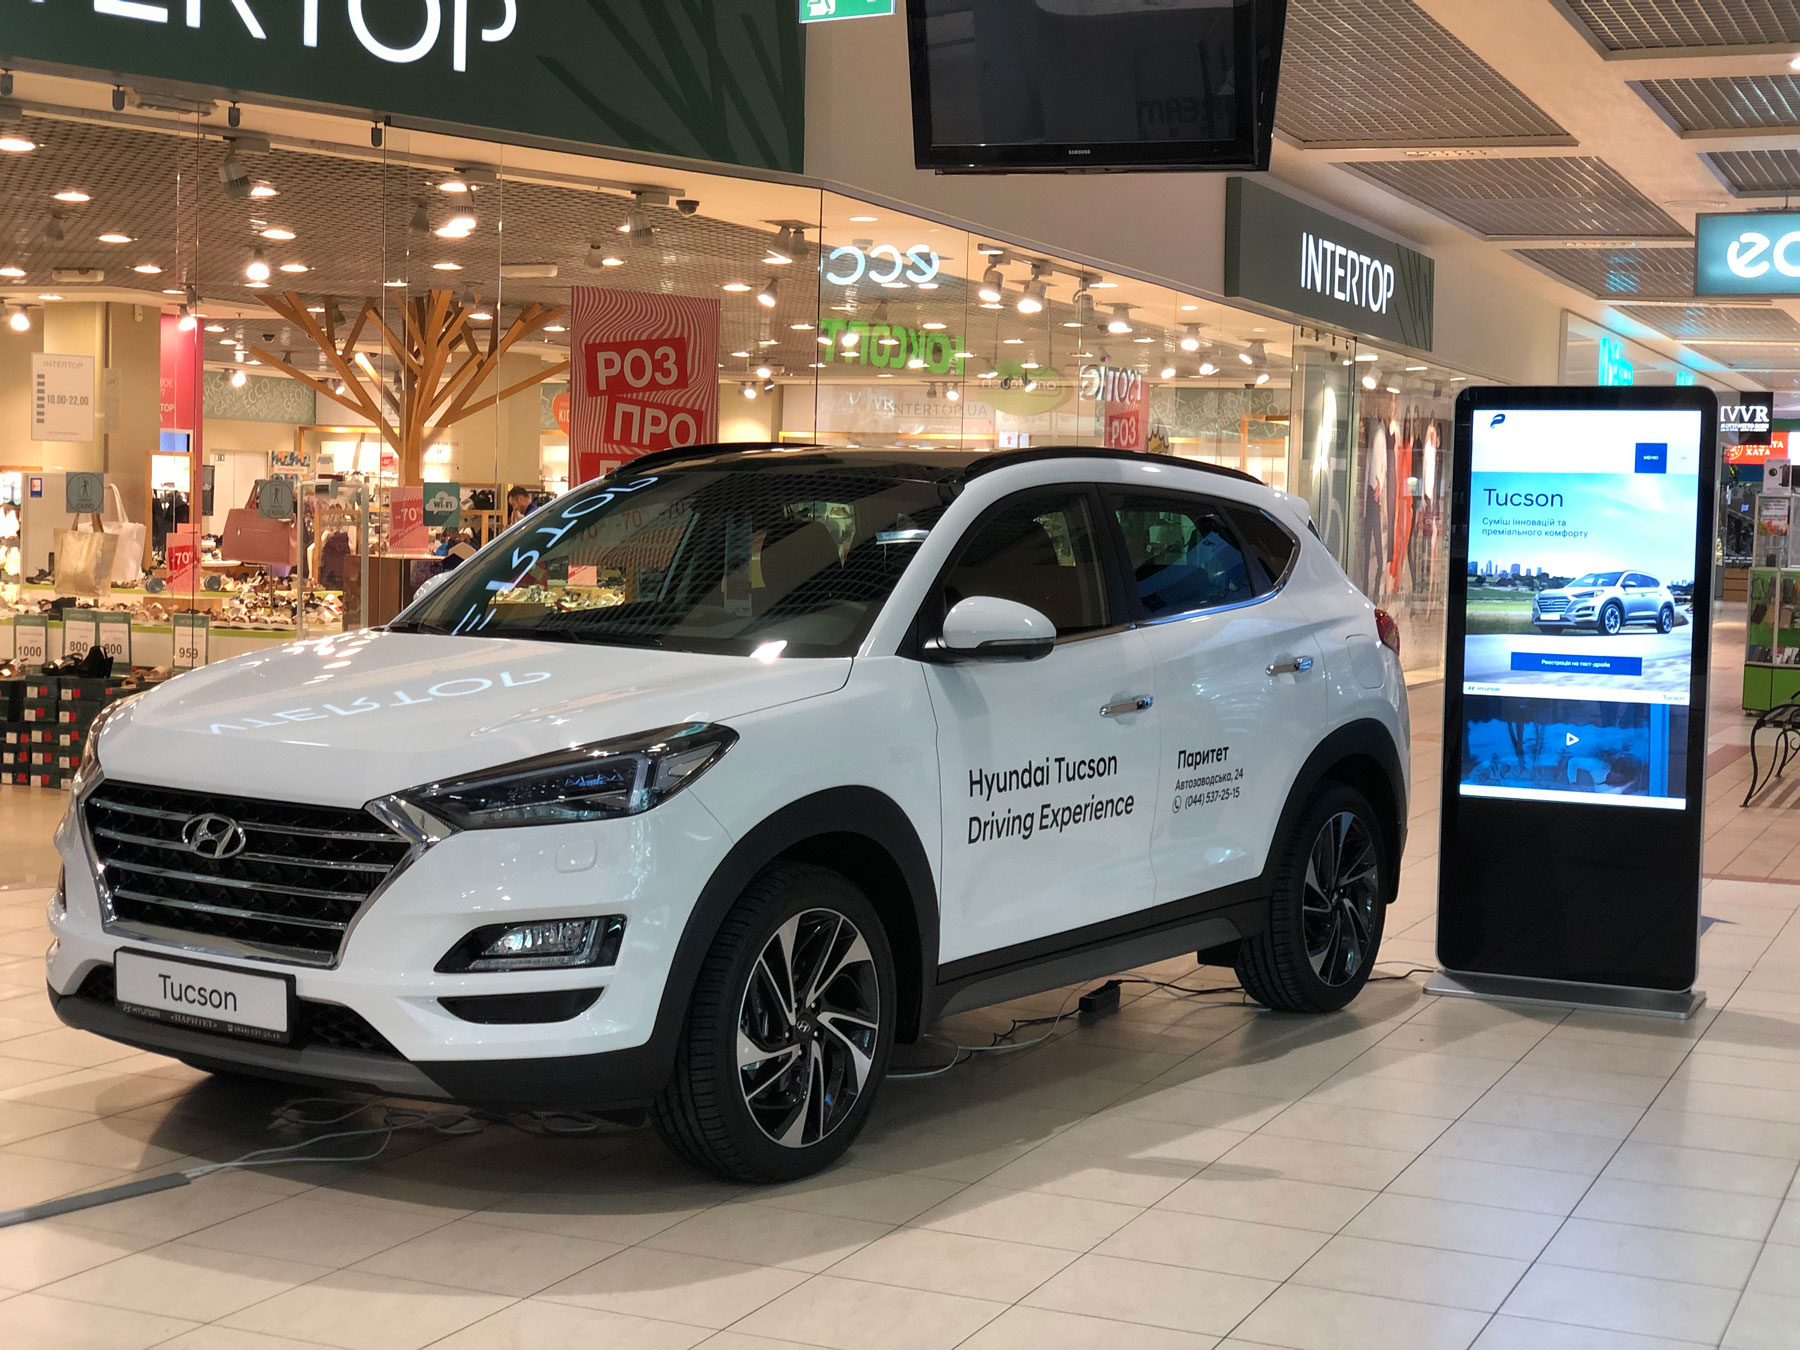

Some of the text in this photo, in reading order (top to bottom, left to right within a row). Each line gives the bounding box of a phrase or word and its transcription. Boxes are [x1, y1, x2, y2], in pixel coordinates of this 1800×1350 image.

[1301, 232, 1394, 314] INTERTOP
[43, 361, 84, 369] INTERTOP
[596, 346, 679, 391] РОЗ
[47, 394, 89, 406] 10.00-22.00
[893, 403, 988, 418] NTERTOP.UA
[613, 402, 698, 449] ПРО
[1111, 415, 1137, 447] РОЗ
[1746, 448, 1771, 456] ХАТА
[1483, 488, 1564, 508] Tucson
[1482, 517, 1511, 526] Суміш
[1512, 518, 1555, 527] інновацій
[1481, 528, 1588, 538] преміального комфорту
[18, 646, 42, 657] 1000
[69, 641, 88, 653] 800
[104, 643, 123, 655] 800
[1177, 746, 1229, 770] Паритет
[969, 755, 1118, 801] Hyundai Tucson
[1175, 768, 1244, 791] Автозаводська, 24
[1185, 786, 1240, 810] (044) 537-25-15
[968, 794, 1135, 844] Driving Experience
[158, 973, 237, 1012] Tucson
[132, 1006, 161, 1018] HYUNDAI
